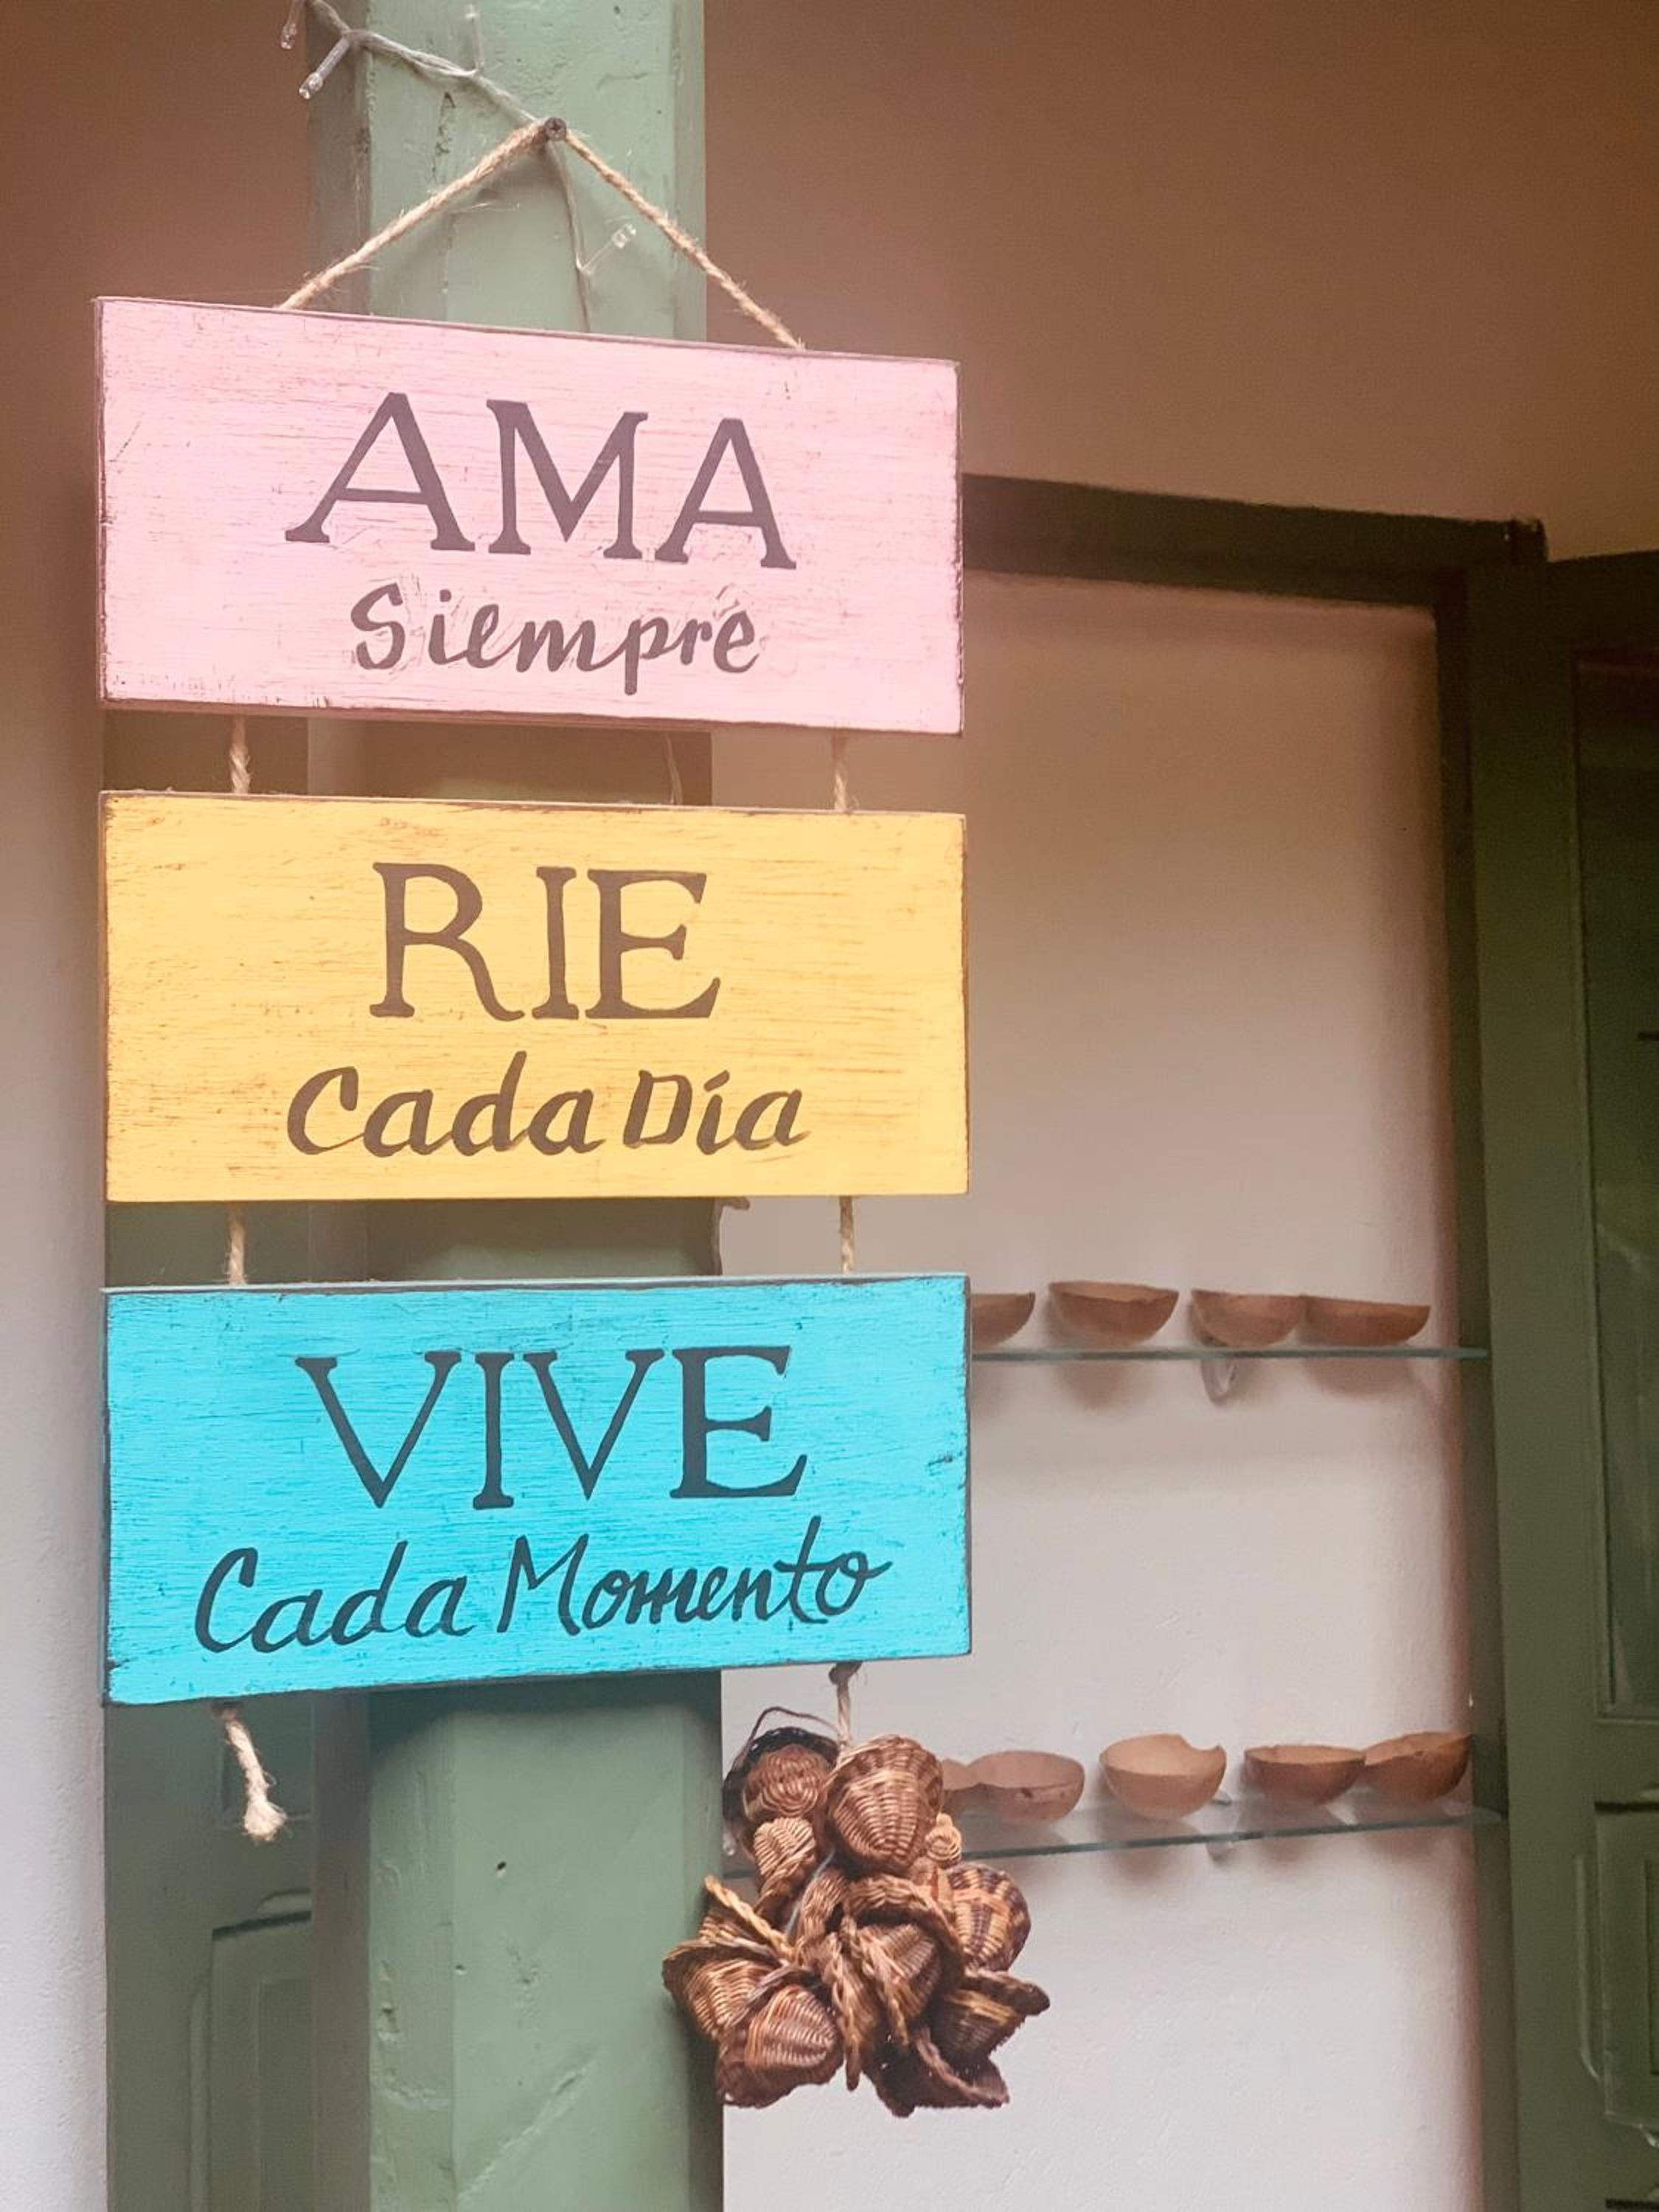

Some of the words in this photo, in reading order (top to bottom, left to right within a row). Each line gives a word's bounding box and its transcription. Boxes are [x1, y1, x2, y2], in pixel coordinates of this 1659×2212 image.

[285, 392, 797, 570] AMA
[349, 580, 758, 695] Siempre
[369, 862, 720, 1022] RIE
[287, 1051, 603, 1158] Cada
[622, 1069, 810, 1156] Día
[294, 1345, 809, 1509] VIVE
[194, 1540, 476, 1654] Cada
[495, 1515, 893, 1636] Momento
